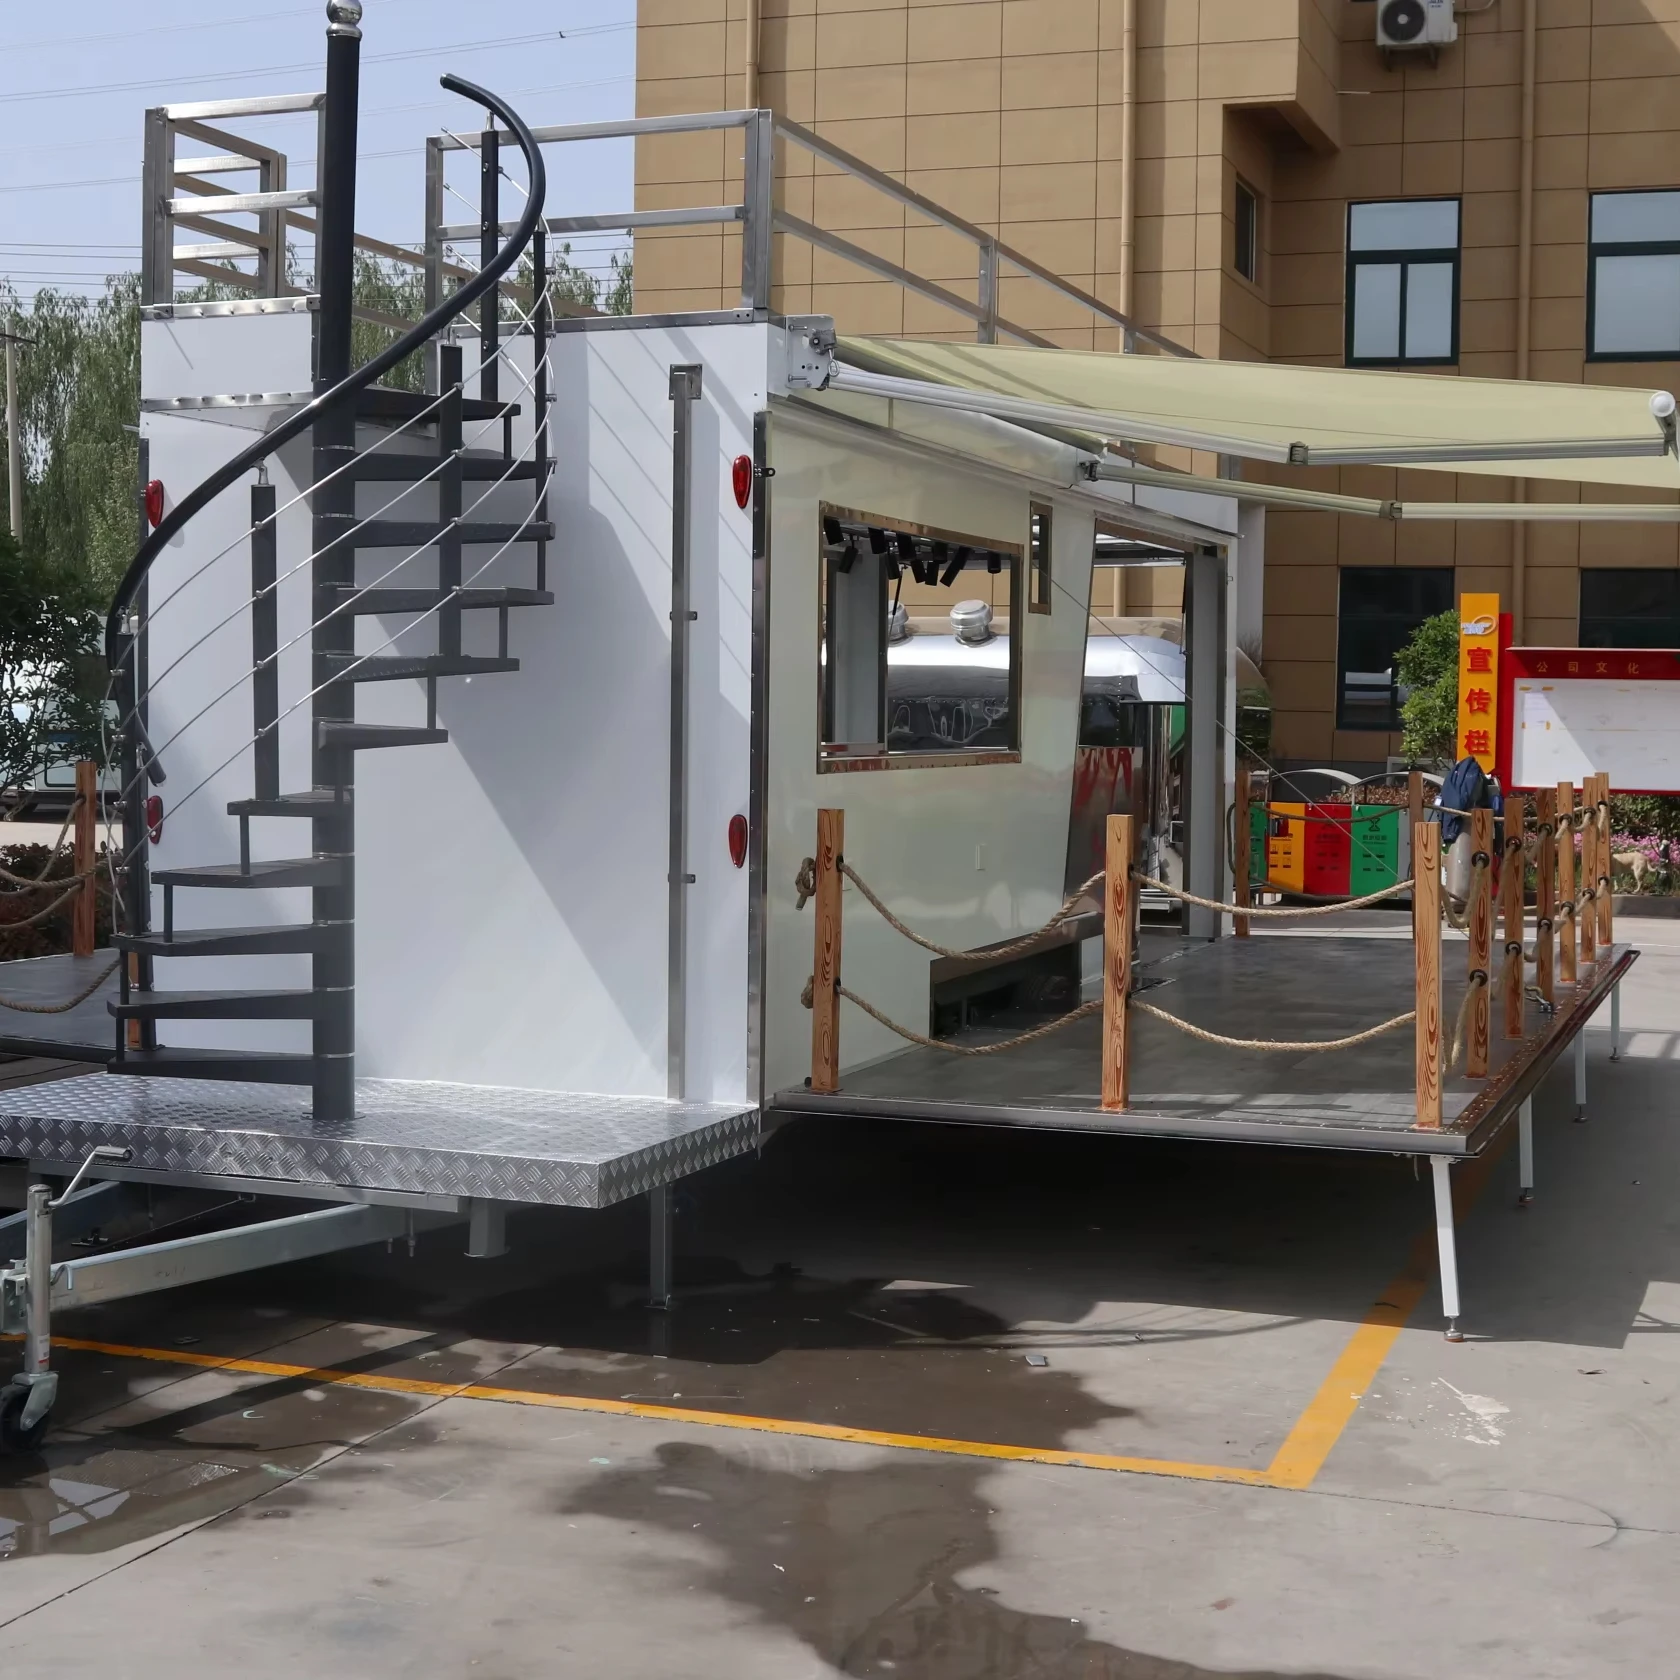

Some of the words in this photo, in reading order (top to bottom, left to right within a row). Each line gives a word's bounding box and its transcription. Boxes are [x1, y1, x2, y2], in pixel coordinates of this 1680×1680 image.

[1536, 661, 1640, 674] 公司文化
[1464, 647, 1492, 755] 宣传栏
